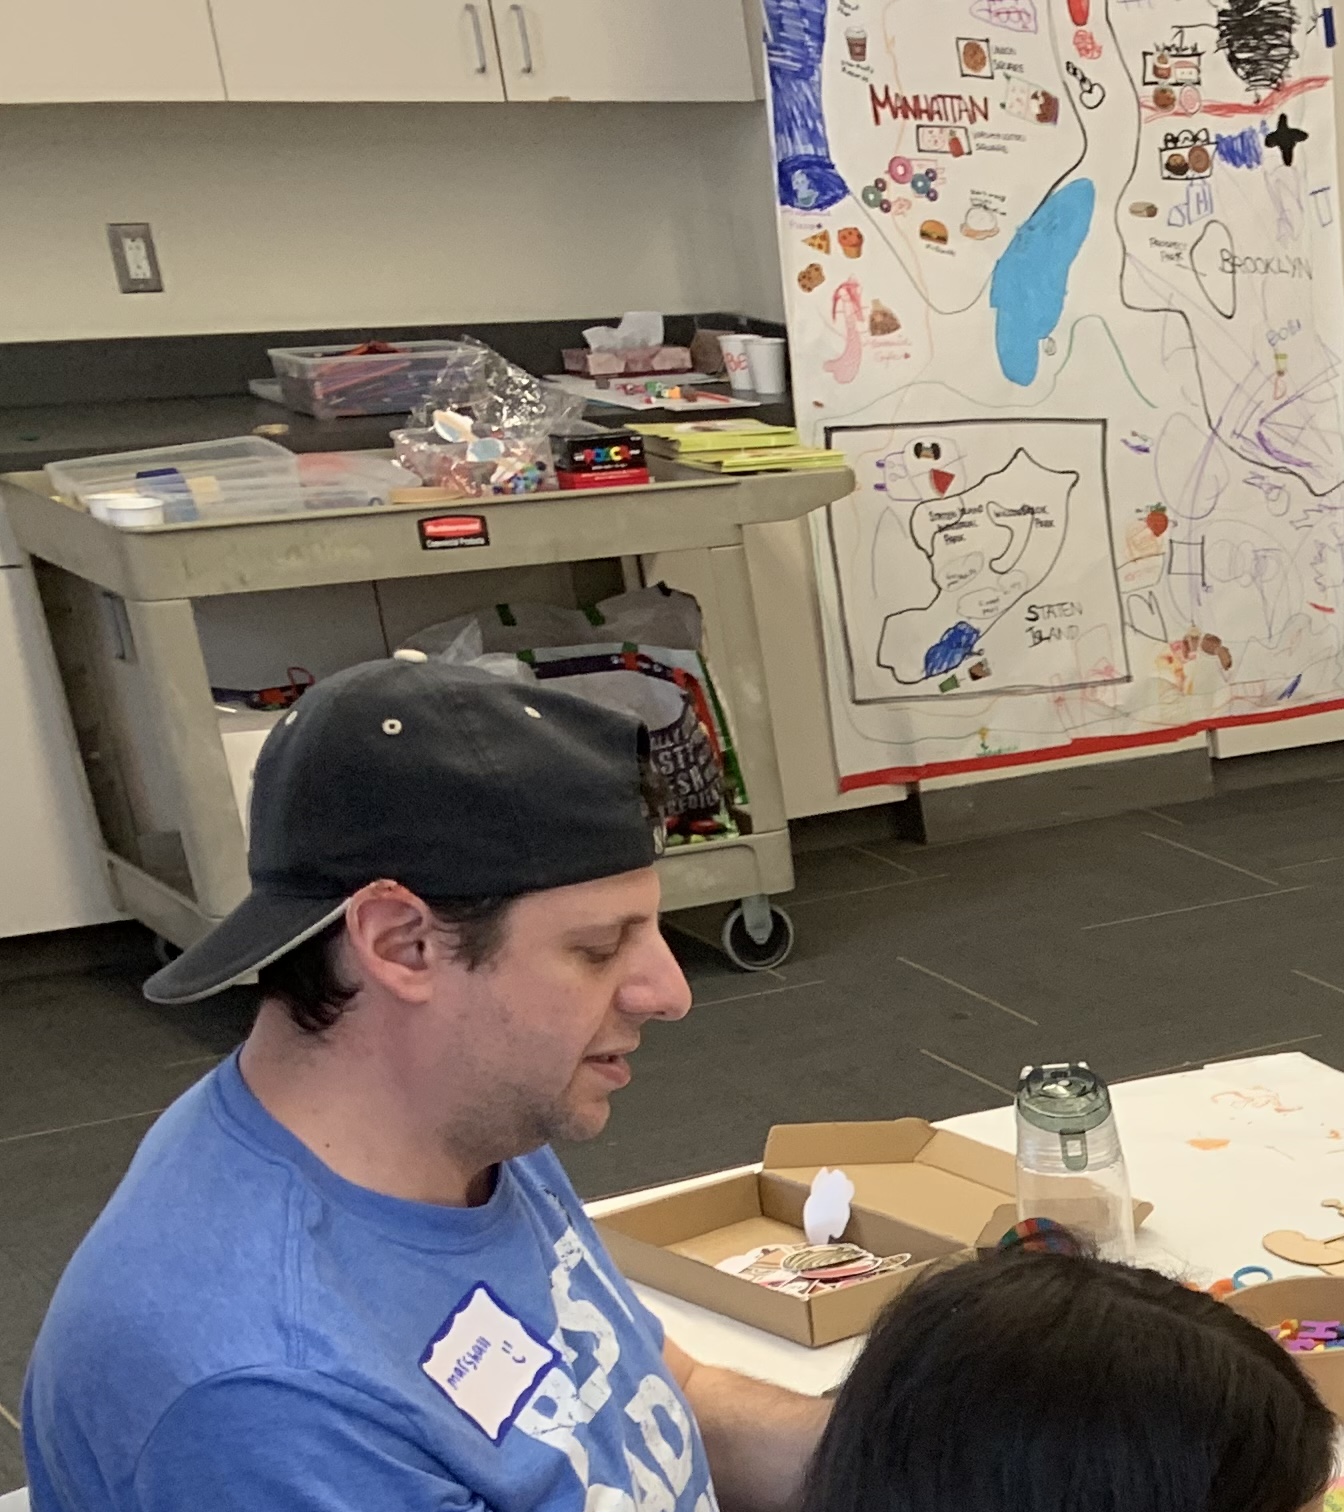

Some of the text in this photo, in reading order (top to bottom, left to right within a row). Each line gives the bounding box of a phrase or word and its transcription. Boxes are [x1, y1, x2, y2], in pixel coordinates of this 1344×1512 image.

[868, 84, 989, 126] MANHATTAN
[1218, 248, 1313, 280] BROOKLYN
[1024, 602, 1083, 622] STATEN
[1025, 625, 1080, 648] ISLAND
